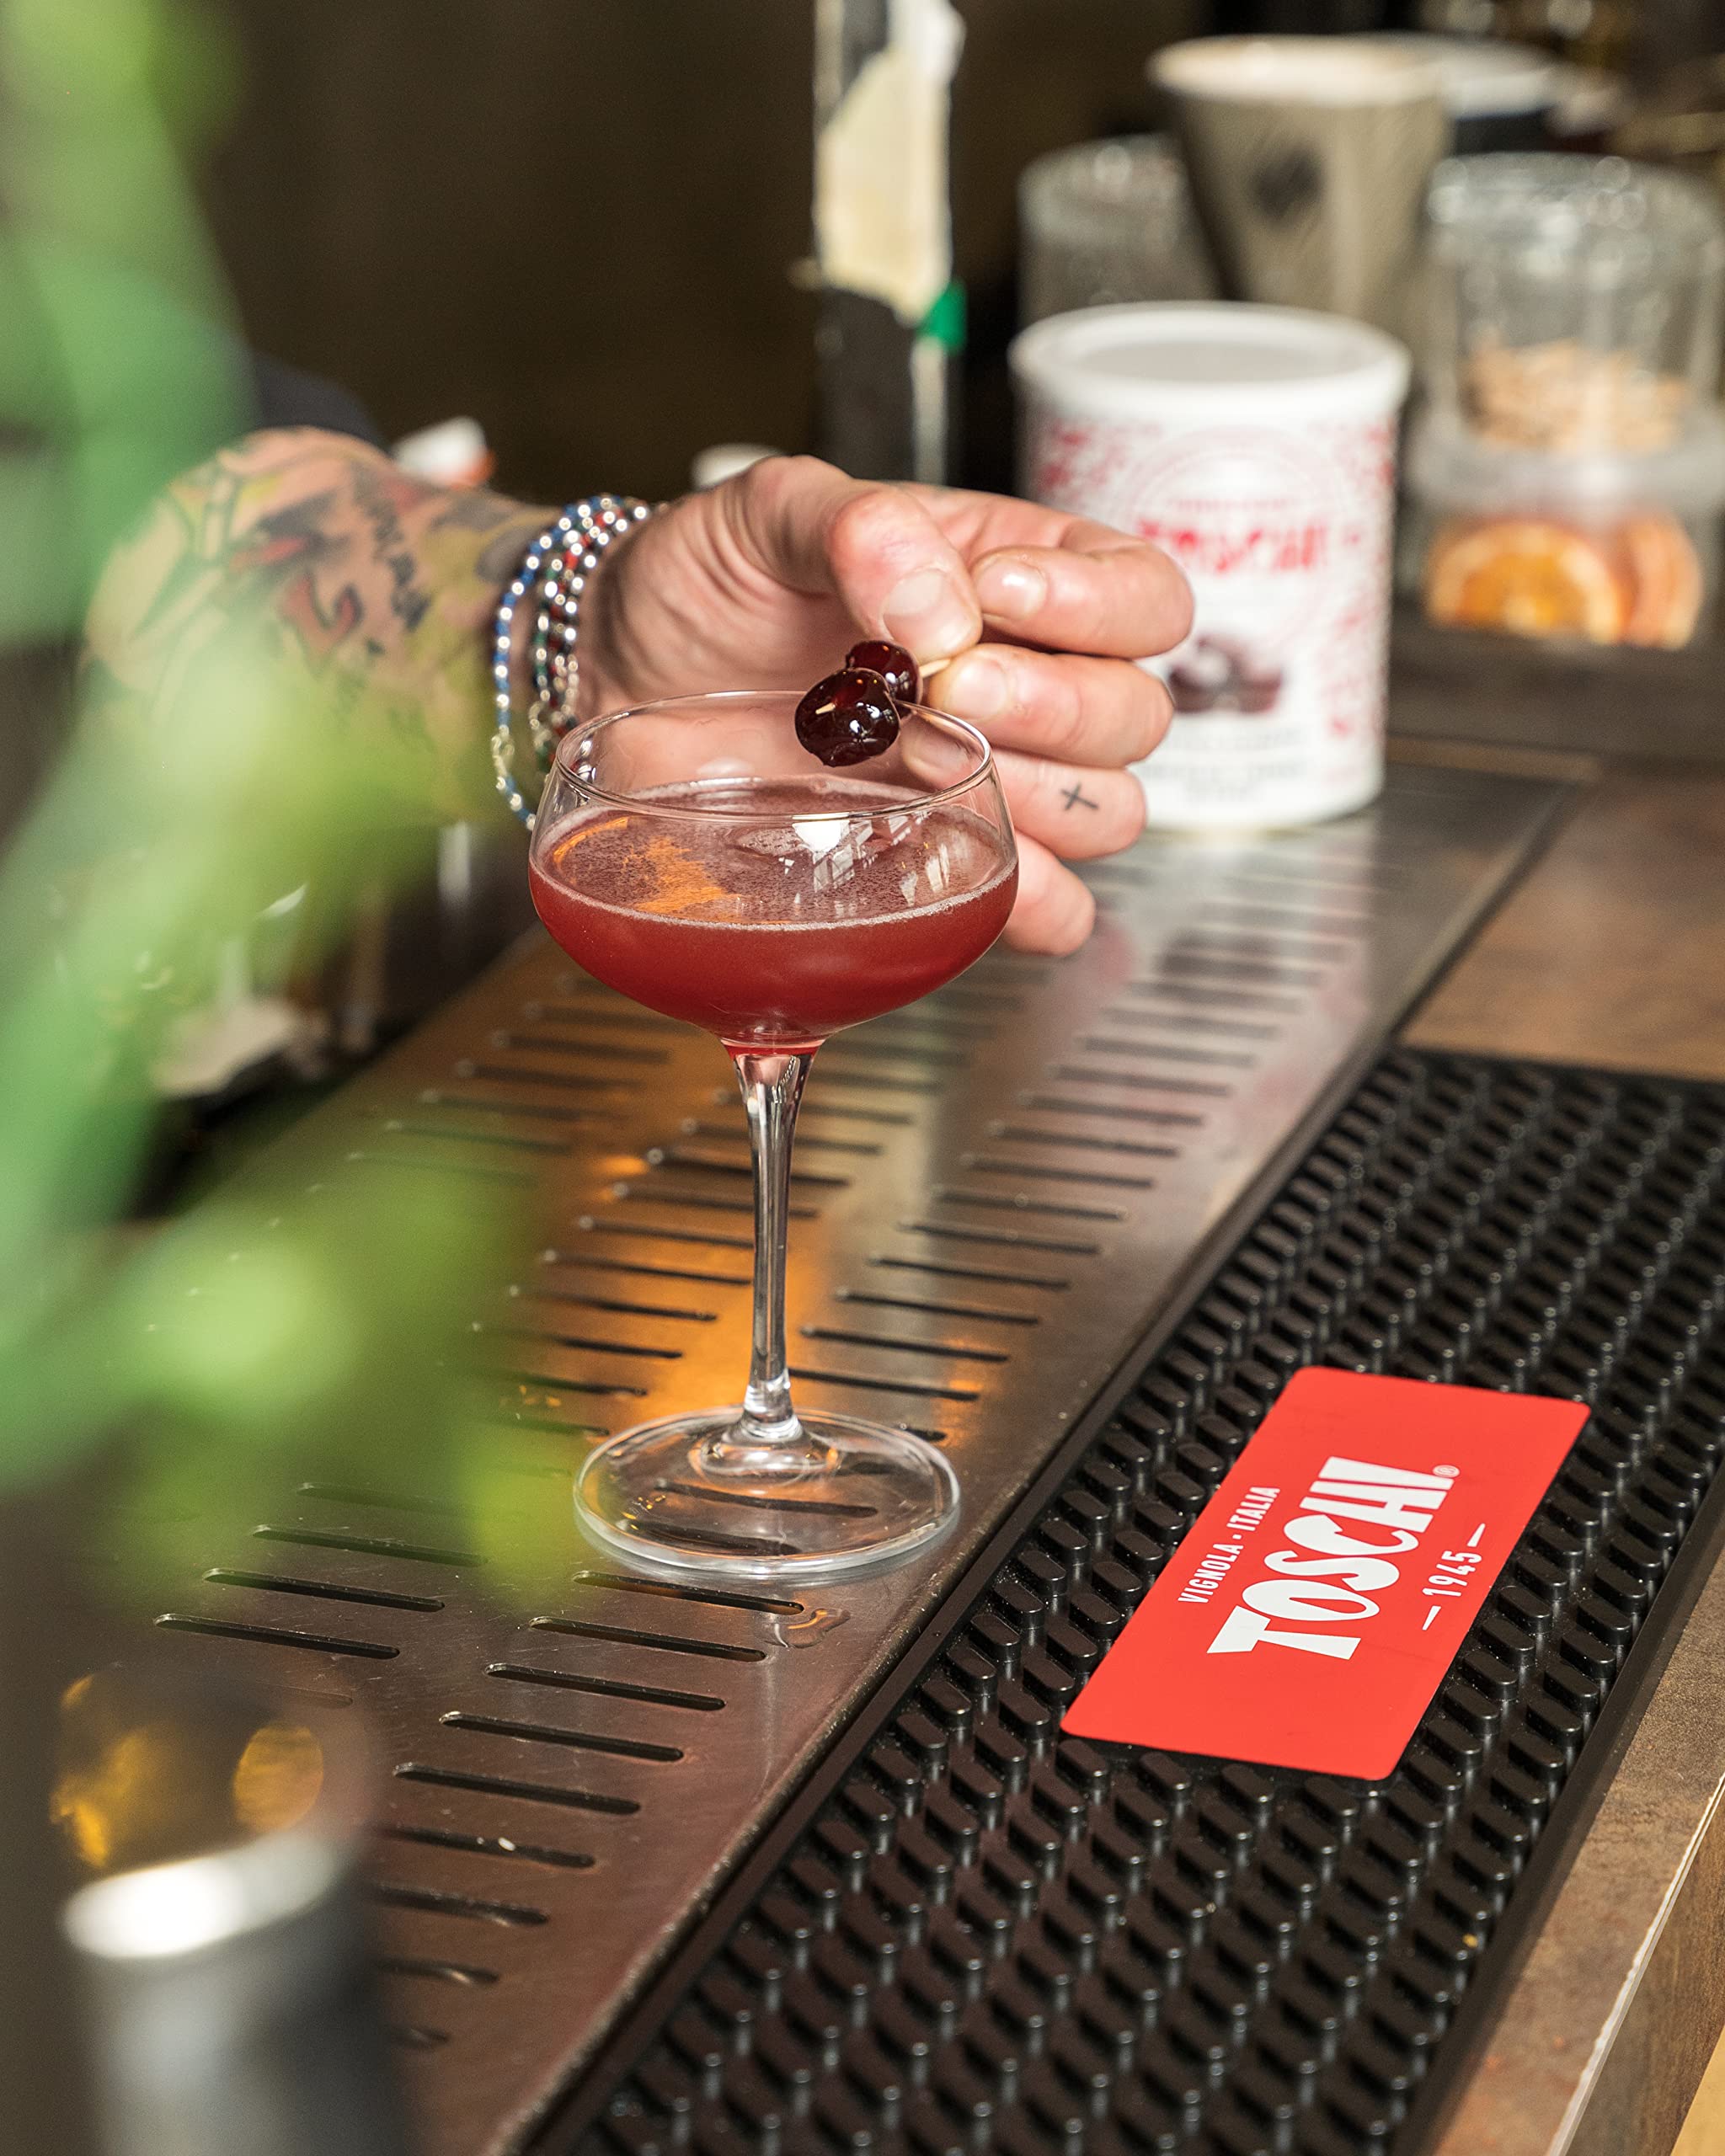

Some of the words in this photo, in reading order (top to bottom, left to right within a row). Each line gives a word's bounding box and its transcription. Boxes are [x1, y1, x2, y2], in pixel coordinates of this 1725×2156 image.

[1178, 1543, 1244, 1604] VIGNOLA
[1226, 1486, 1281, 1532] ITALIA
[1206, 1456, 1455, 1660] TOSCHI
[1422, 1550, 1482, 1597] 1945
